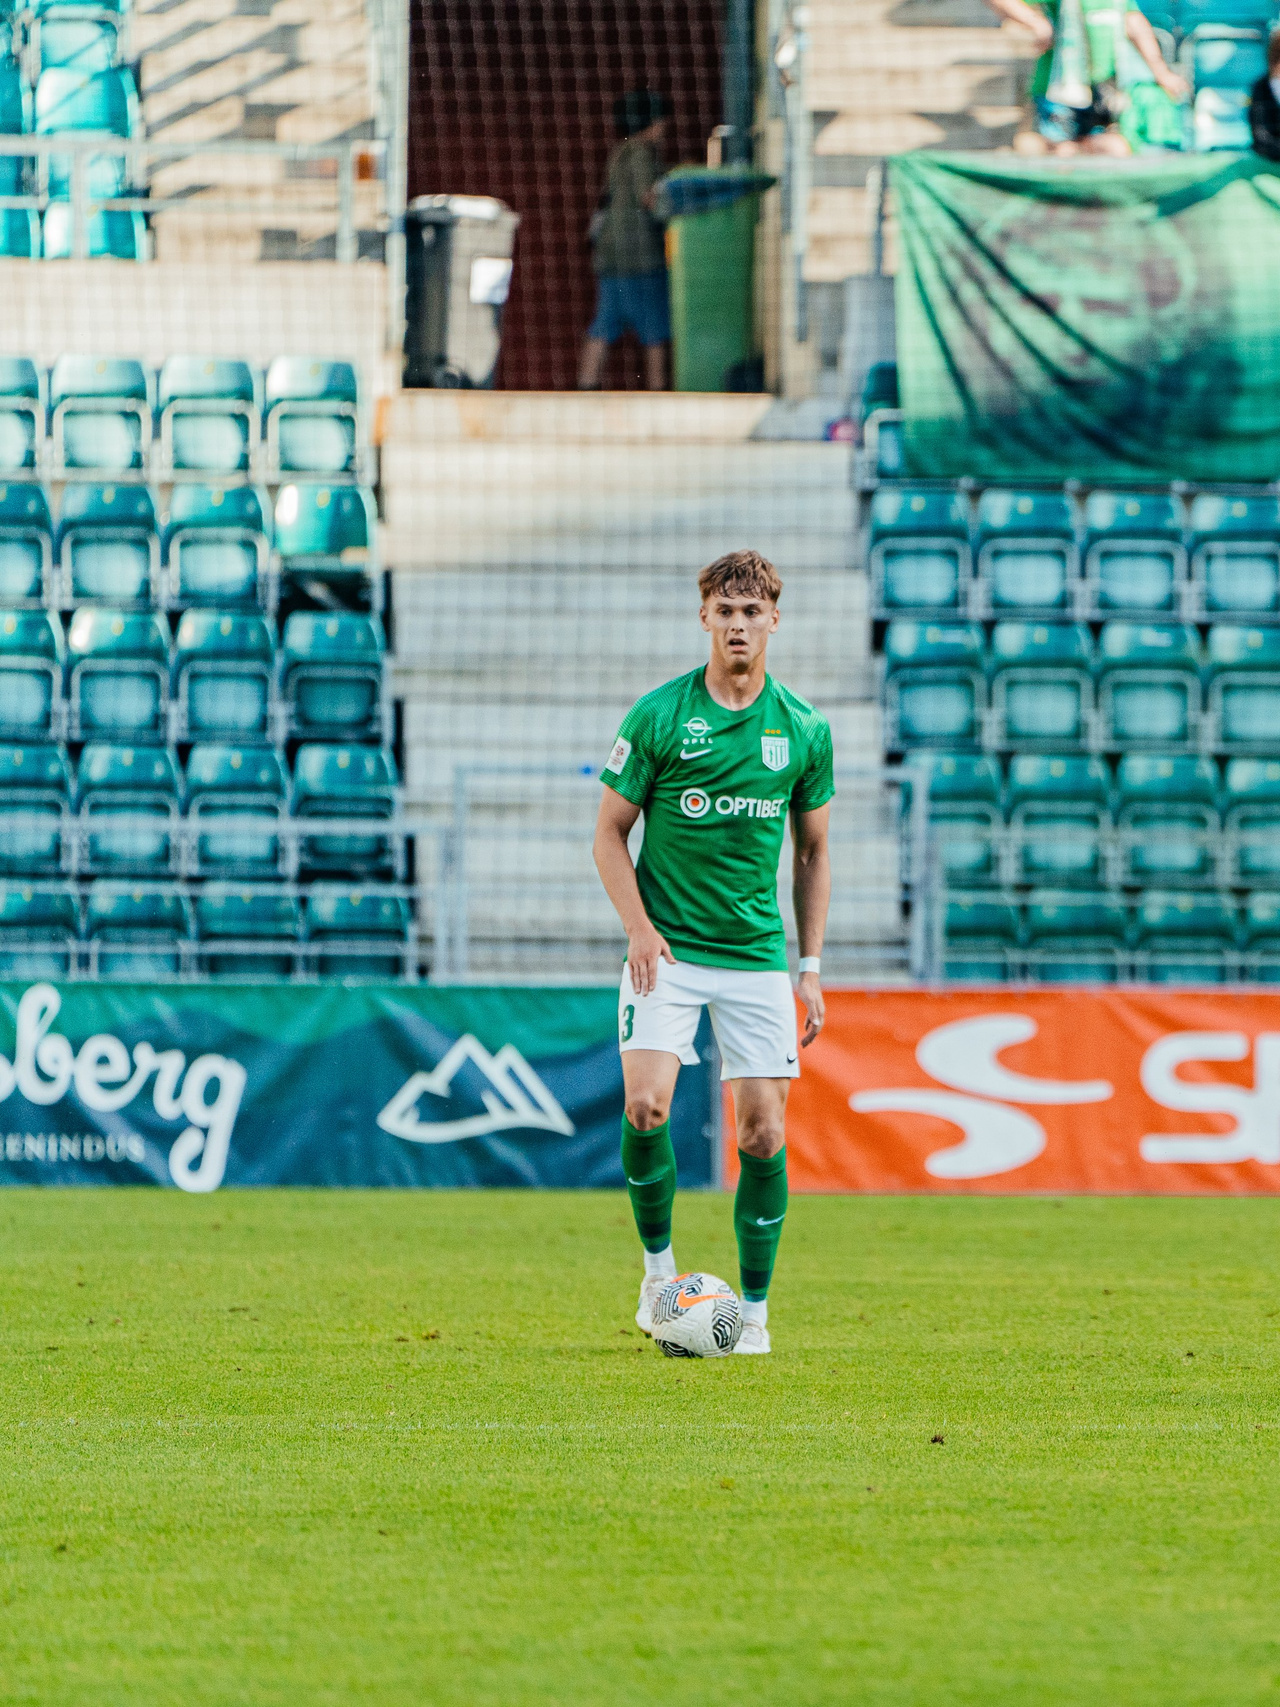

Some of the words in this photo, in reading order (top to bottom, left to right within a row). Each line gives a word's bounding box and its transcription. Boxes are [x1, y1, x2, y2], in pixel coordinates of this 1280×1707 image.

[682, 737, 714, 746] OPEL
[715, 795, 785, 819] OPTIBET
[621, 1004, 636, 1044] 3
[0, 983, 248, 1193] berg
[0, 1132, 146, 1163] ENINDUS
